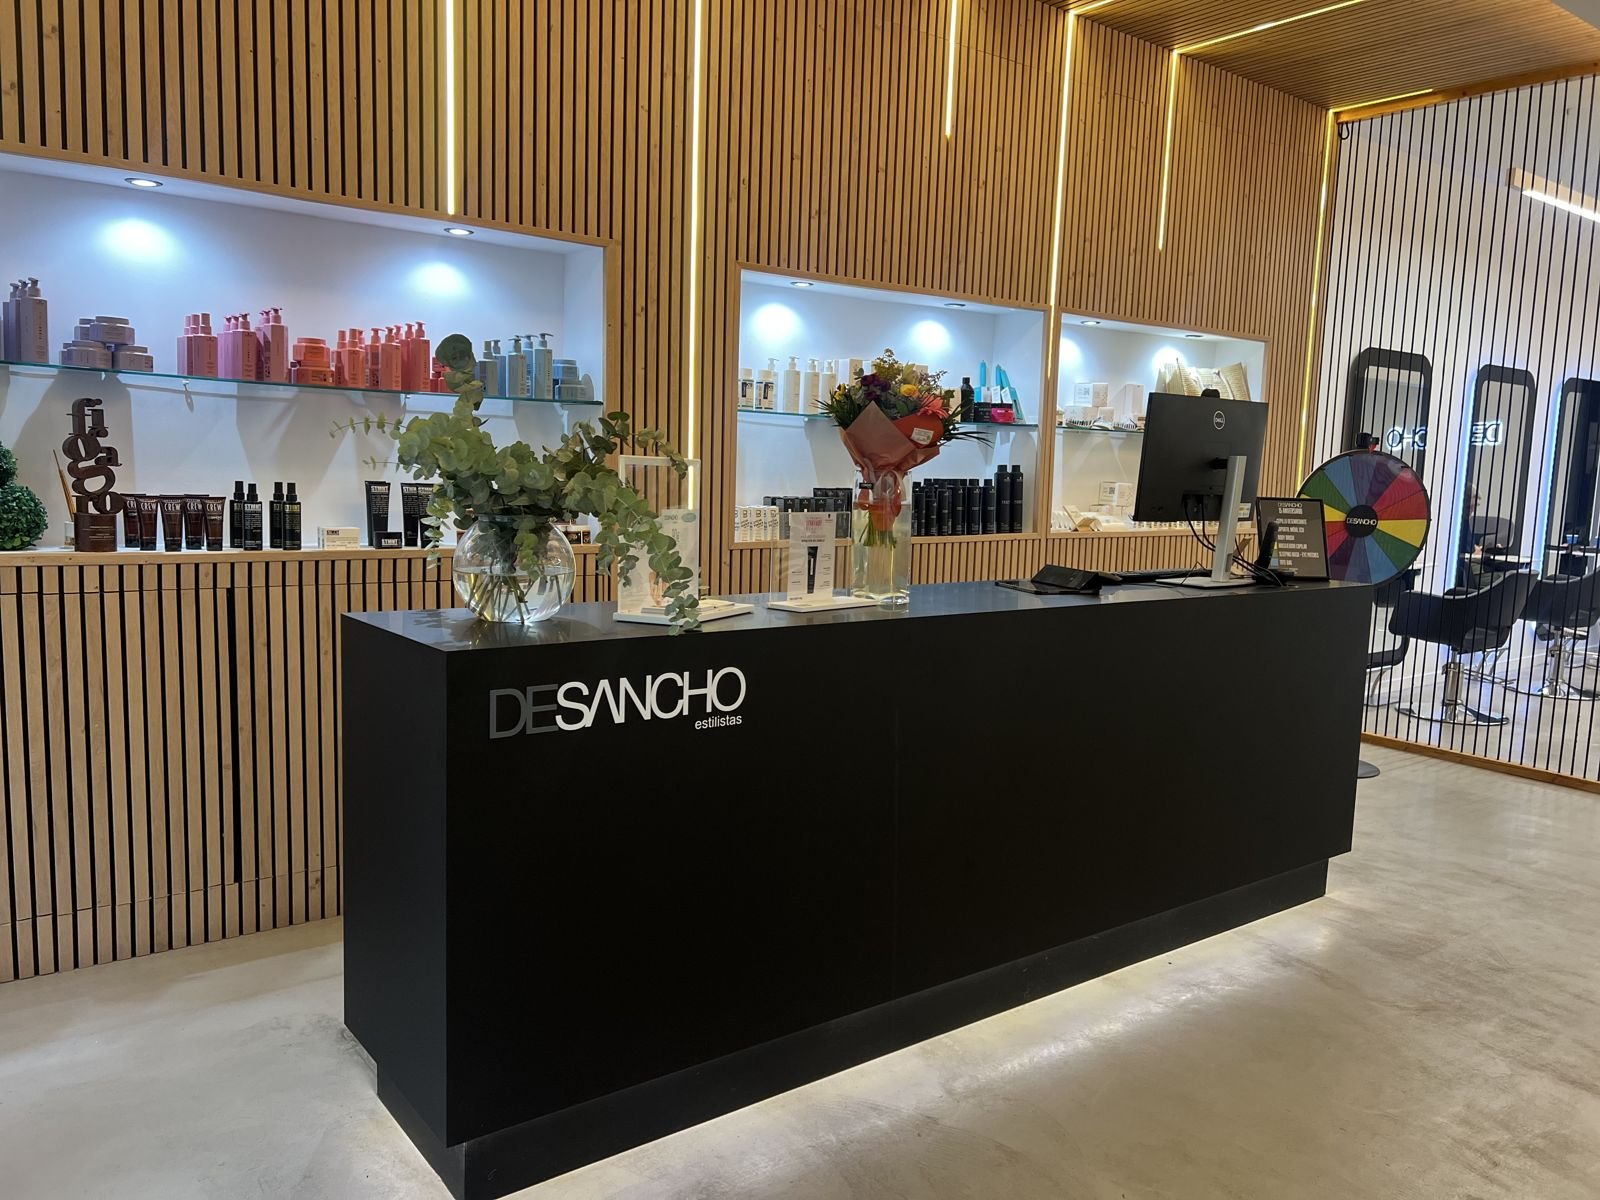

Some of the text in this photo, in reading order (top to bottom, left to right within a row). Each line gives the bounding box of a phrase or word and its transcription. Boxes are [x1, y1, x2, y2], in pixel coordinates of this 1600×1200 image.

[206, 503, 222, 512] CREW
[1346, 517, 1377, 526] DESANCHO
[489, 666, 747, 739] DESANCHO
[694, 714, 743, 730] estilistas
